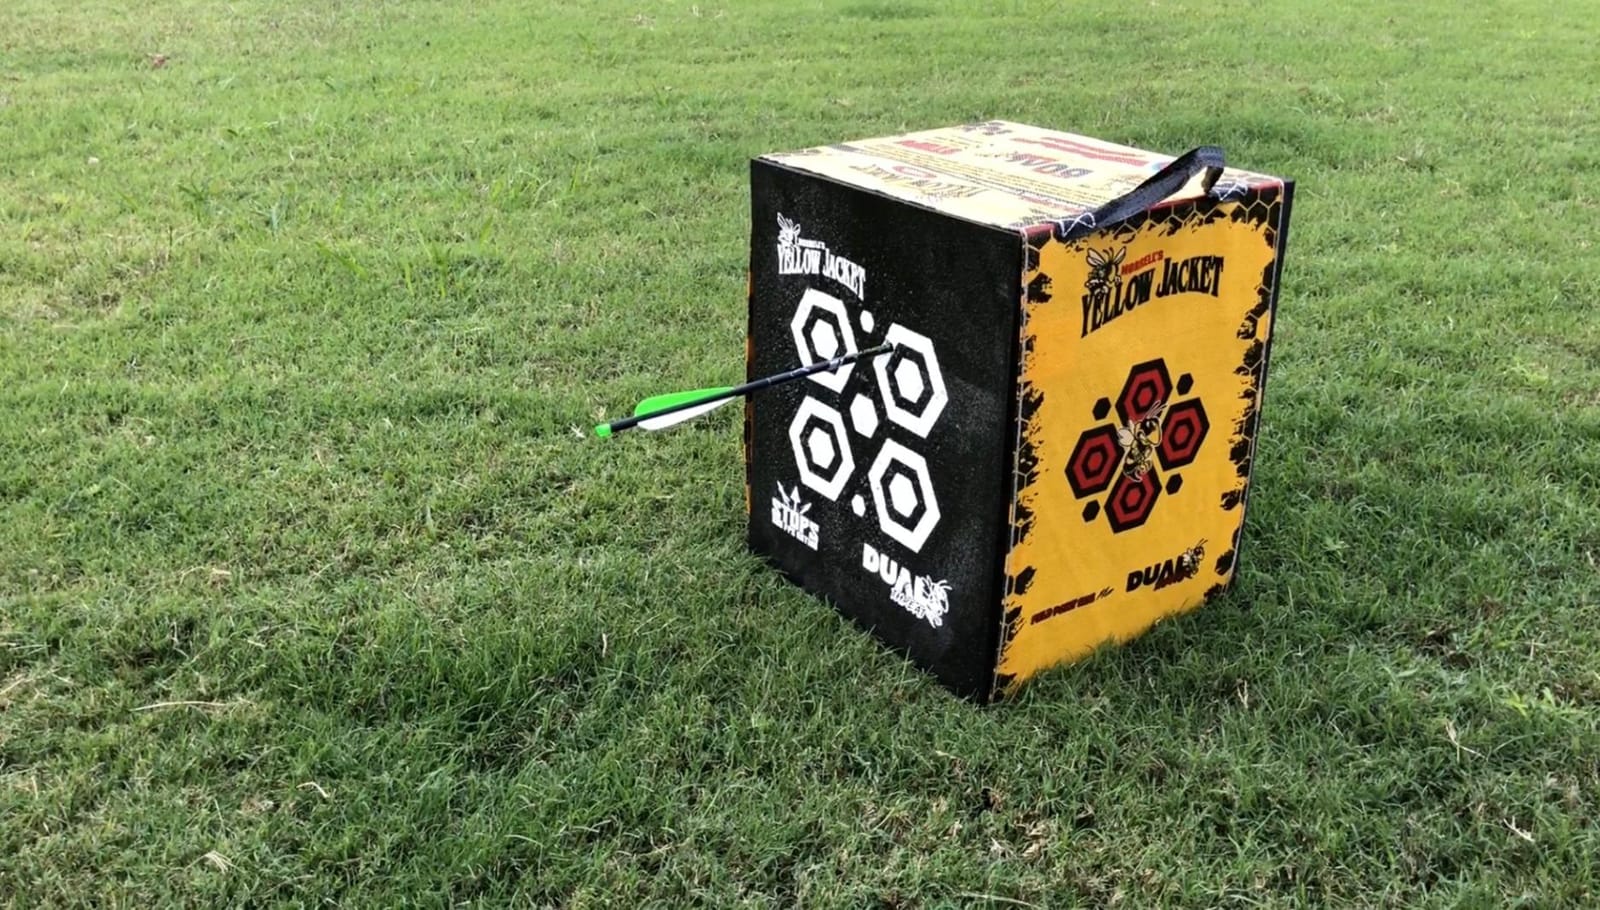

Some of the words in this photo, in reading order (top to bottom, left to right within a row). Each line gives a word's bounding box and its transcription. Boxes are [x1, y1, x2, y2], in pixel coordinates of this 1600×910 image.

[777, 243, 821, 275] YELLOW
[822, 248, 866, 301] JACKET
[1081, 268, 1156, 338] YELLOW
[1156, 256, 1224, 297] JACKET
[772, 497, 820, 538] STOPS
[1126, 556, 1188, 592] DUAL
